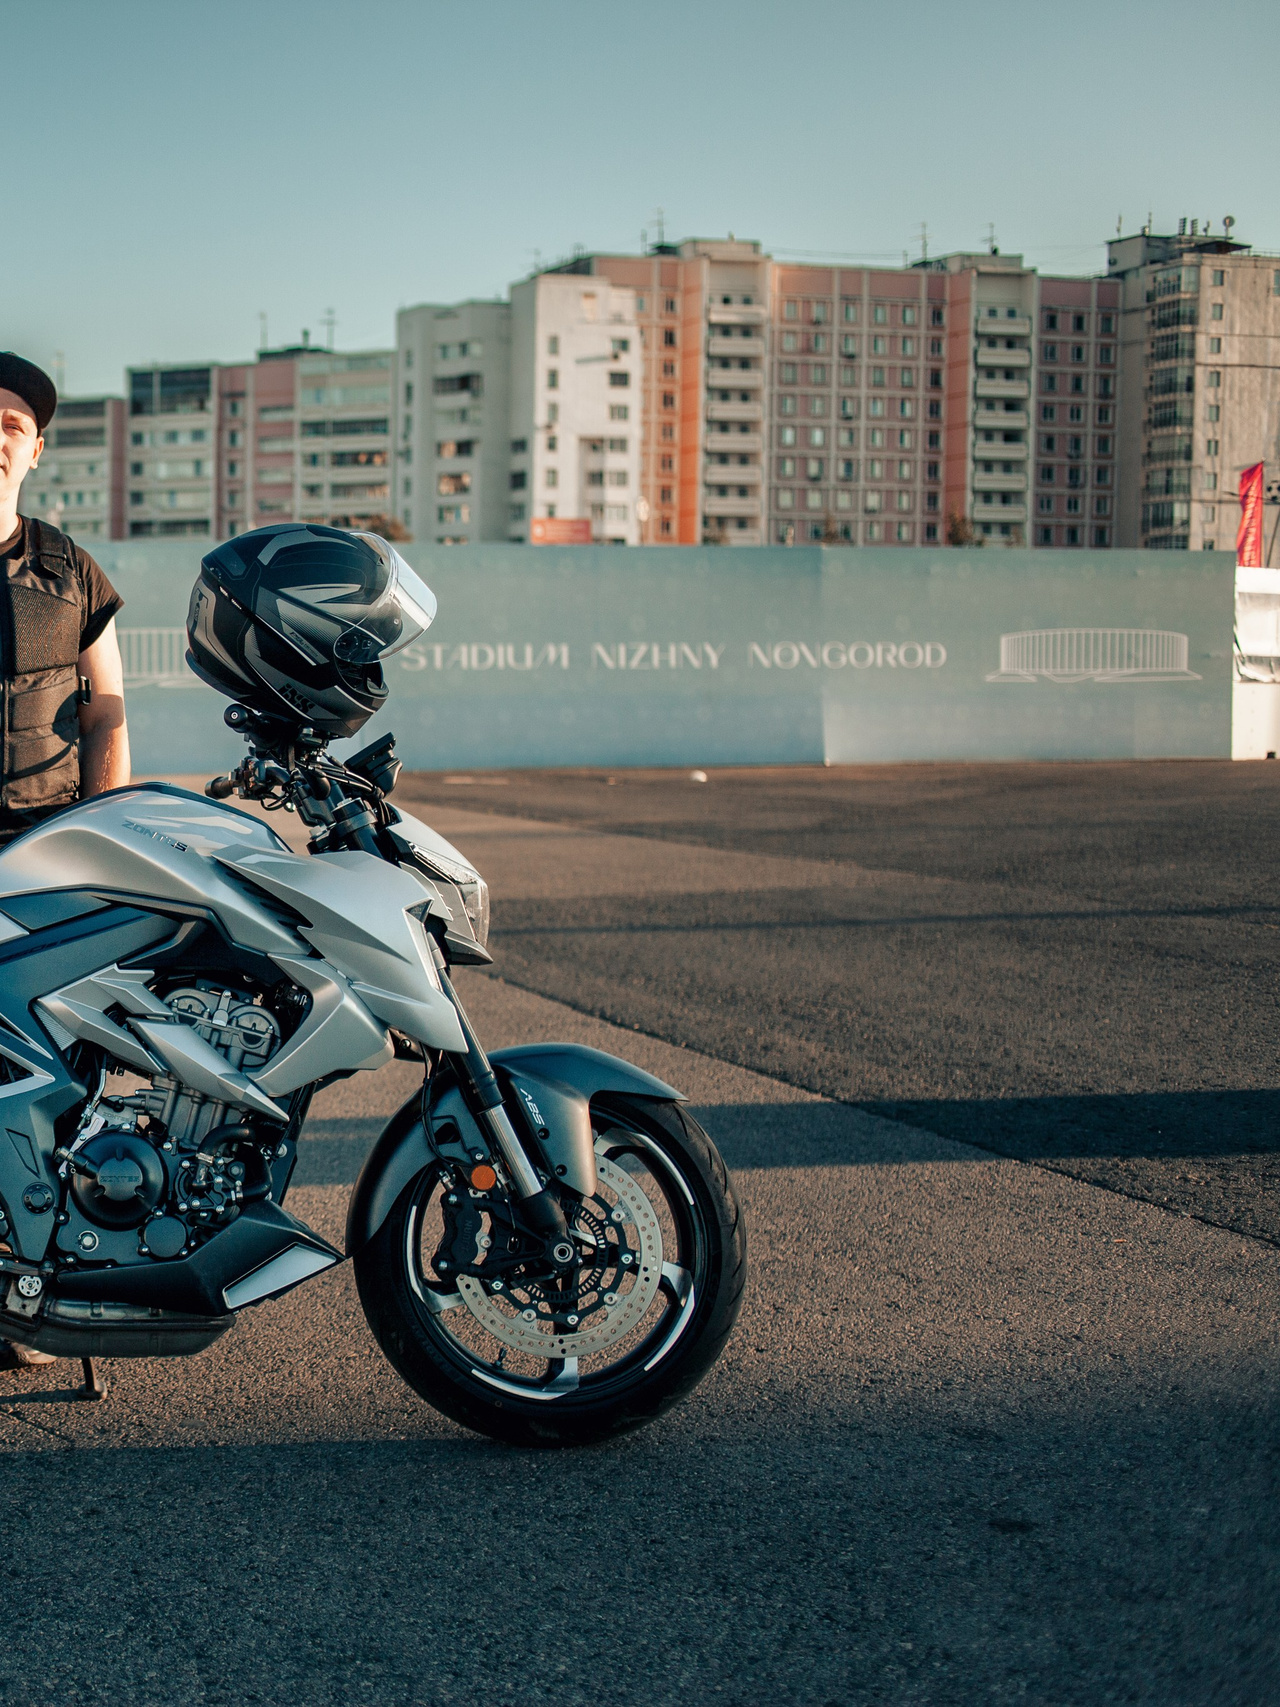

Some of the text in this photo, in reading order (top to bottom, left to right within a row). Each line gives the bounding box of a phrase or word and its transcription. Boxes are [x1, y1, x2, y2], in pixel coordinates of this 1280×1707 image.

[399, 640, 948, 671] STADIUM NIZHNY NOVGOROD
[520, 1087, 545, 1126] ABS
